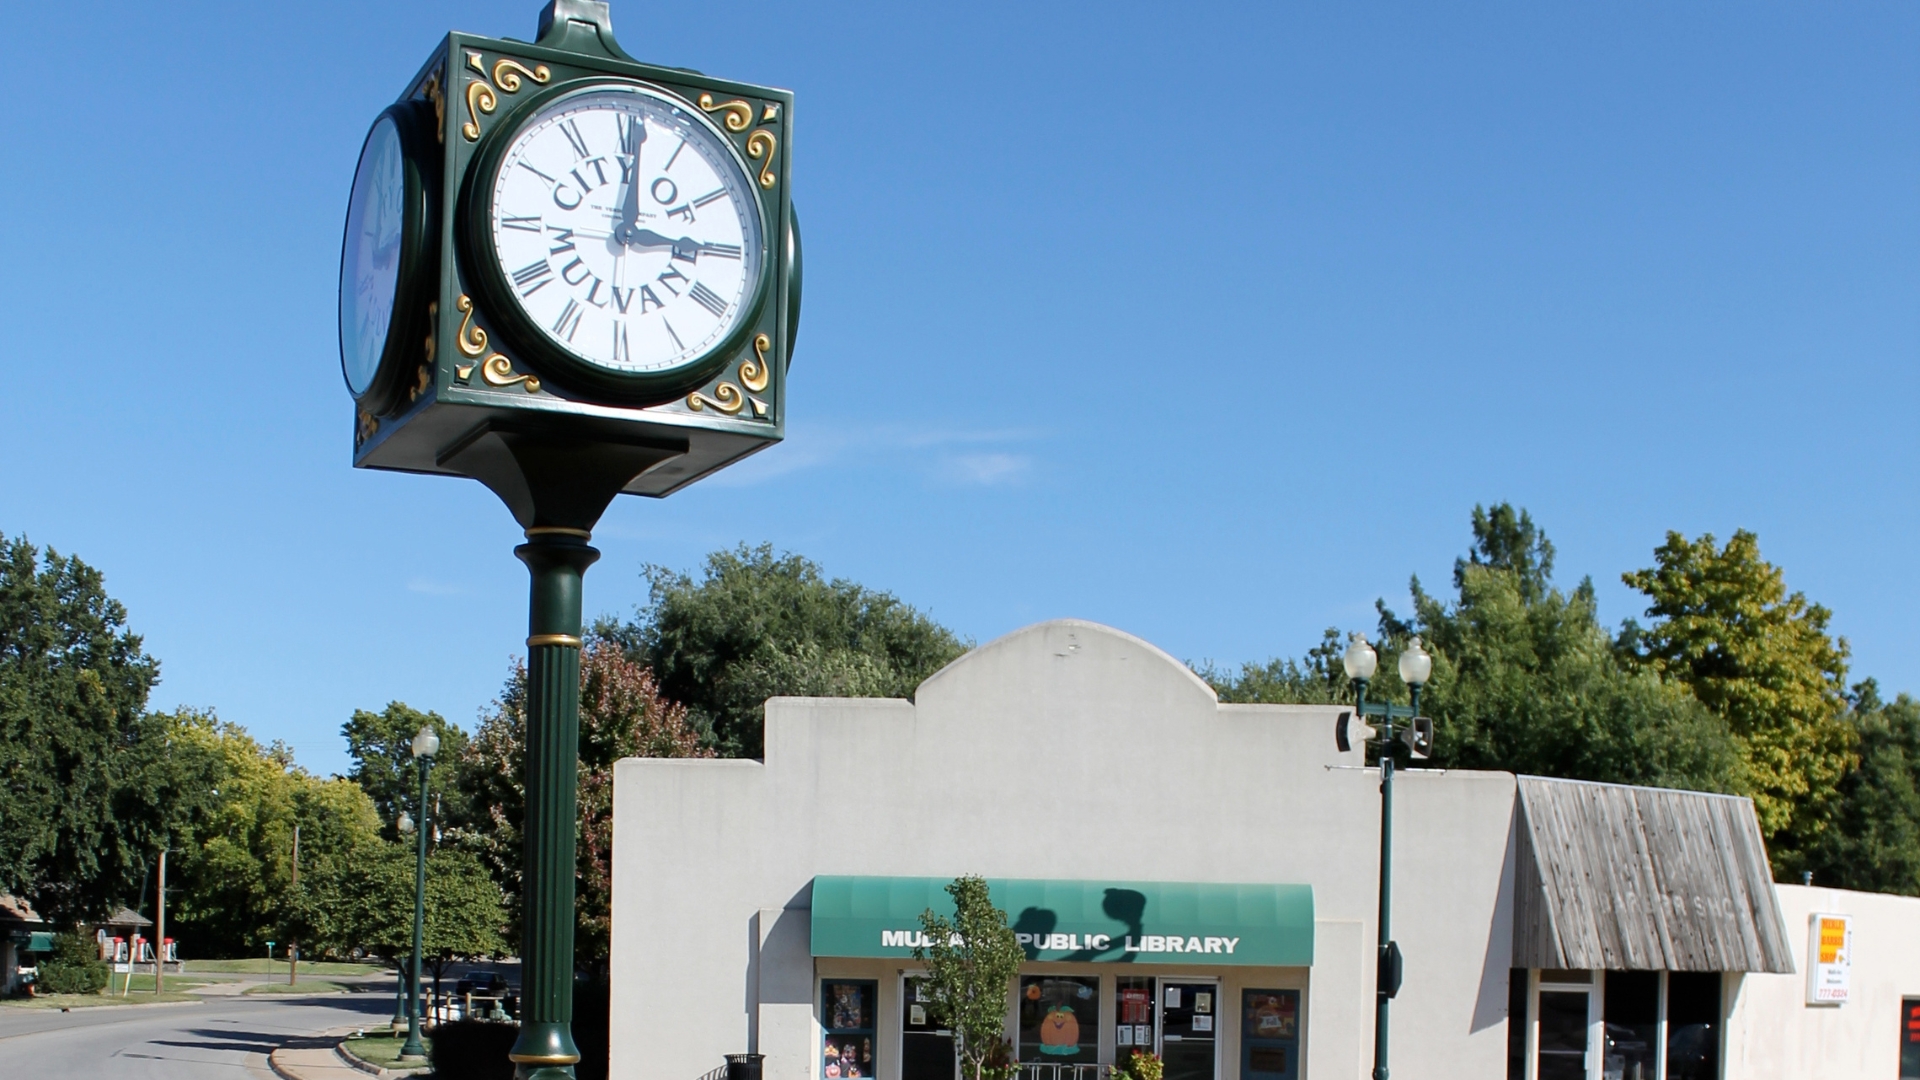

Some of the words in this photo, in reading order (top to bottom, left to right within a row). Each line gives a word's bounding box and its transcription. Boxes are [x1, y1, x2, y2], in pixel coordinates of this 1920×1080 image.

[553, 154, 634, 211] CITY
[651, 177, 696, 225] OF
[545, 224, 697, 315] MULVANE
[1015, 933, 1110, 950] PUBLIC
[1125, 936, 1239, 953] LIBRARY
[1820, 952, 1837, 963] SHOP
